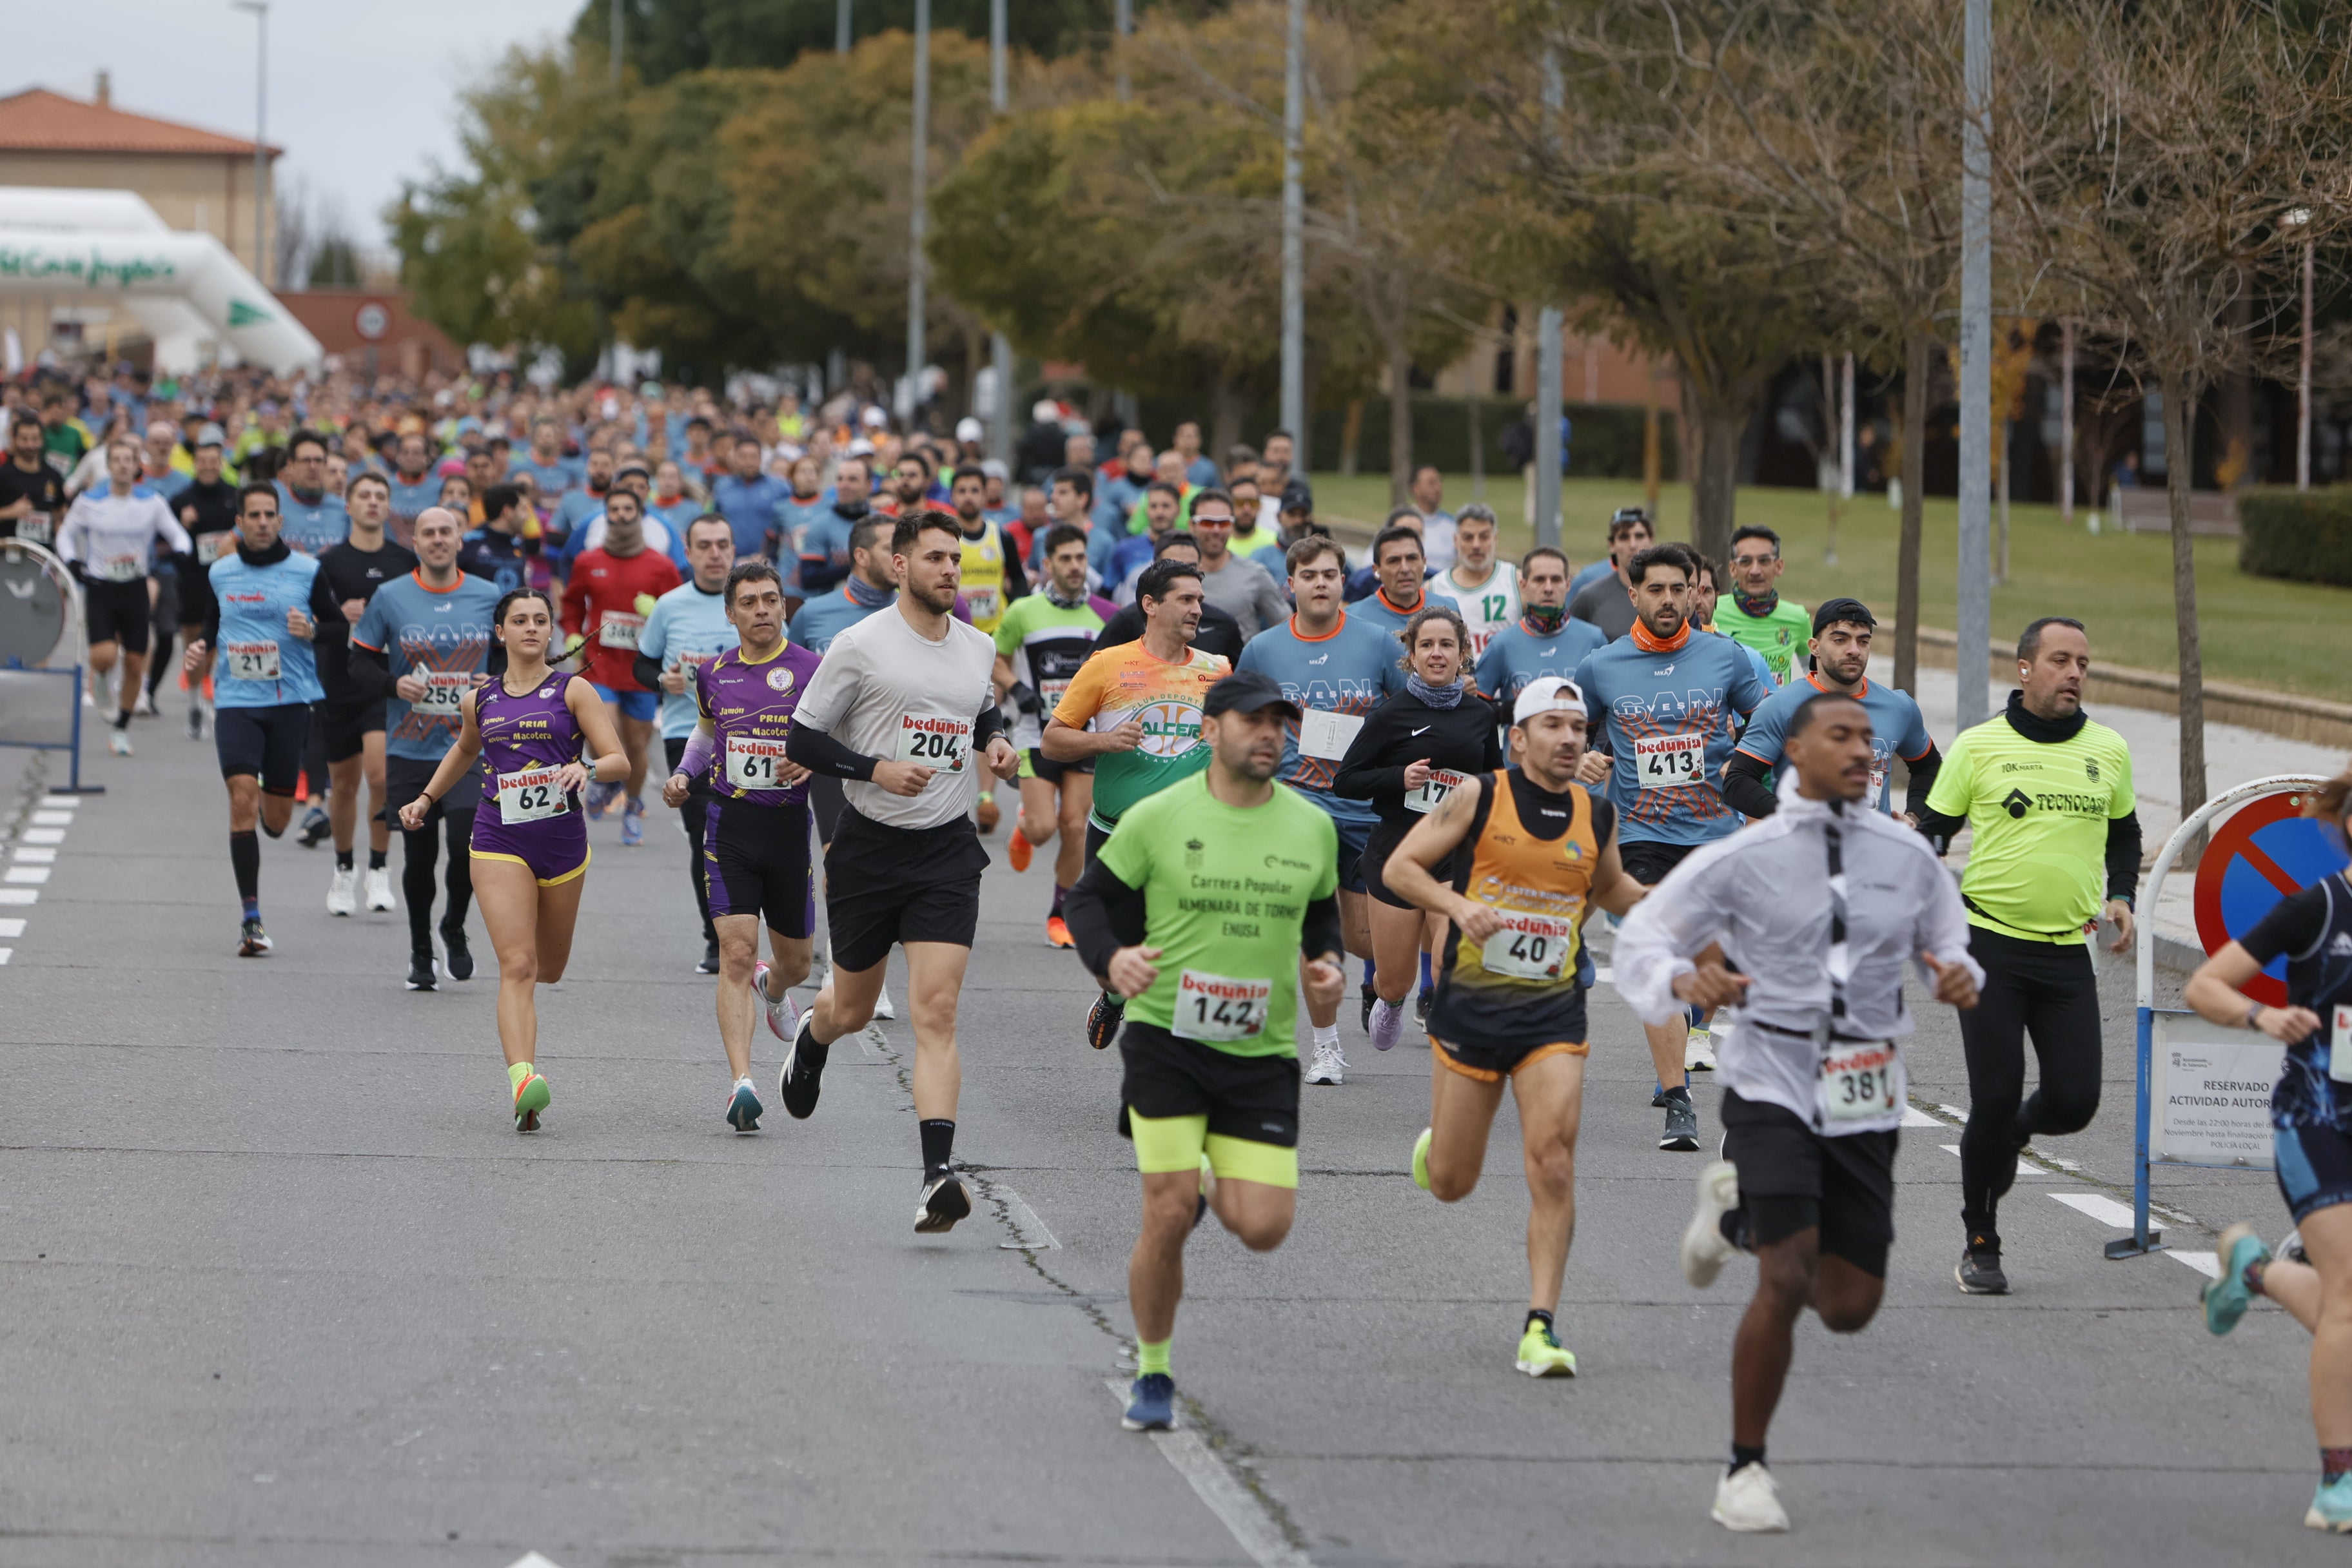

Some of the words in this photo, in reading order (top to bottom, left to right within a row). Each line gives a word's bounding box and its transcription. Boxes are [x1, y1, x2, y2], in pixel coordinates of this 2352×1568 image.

[1482, 596, 1506, 622] 12
[241, 654, 262, 671] 21
[430, 675, 468, 686] dunia
[422, 687, 460, 704] 256
[1132, 696, 1155, 712] CLUB
[1161, 694, 1203, 707] DEPORTI
[1282, 690, 1373, 701] ILVESTRE
[720, 707, 744, 716] Jamón
[1613, 688, 1723, 726] SAN
[1614, 700, 1722, 716] SILVESTRE
[482, 716, 505, 726] Jamón
[760, 714, 788, 723] PRIM
[902, 715, 968, 735] bedunia
[513, 731, 552, 740] Macotera
[752, 727, 789, 736] Macoter
[1142, 721, 1202, 740] ALCER
[728, 740, 783, 756] beduni
[910, 732, 958, 760] 204
[1137, 746, 1200, 763] ALAMANCA
[1637, 737, 1701, 755] bedunia
[743, 756, 770, 778] 61
[1649, 751, 1694, 776] 413
[499, 770, 554, 790] beduni
[1429, 770, 1464, 787] duni
[519, 786, 550, 810] 62
[1422, 781, 1454, 804] 17
[1191, 874, 1241, 890] Carrera
[1244, 877, 1293, 896] Popular
[1177, 897, 1241, 916] ALMENARA
[1244, 901, 1260, 917] DE
[1222, 921, 1260, 939] ENUSA
[1506, 917, 1567, 937] edunia
[1509, 934, 1546, 964] 40
[1195, 997, 1253, 1026] 142
[2204, 1080, 2270, 1093] RESERVADO
[2169, 1096, 2228, 1107] ACTIVIDAD
[2232, 1098, 2271, 1109] AUTOR
[2173, 1118, 2195, 1126] Desde
[2231, 1120, 2251, 1128] horas
[2164, 1129, 2204, 1137] Noviembre
[2206, 1130, 2225, 1138] hasta
[2227, 1131, 2268, 1141] finalización
[2239, 1142, 2261, 1151] LOCAL
